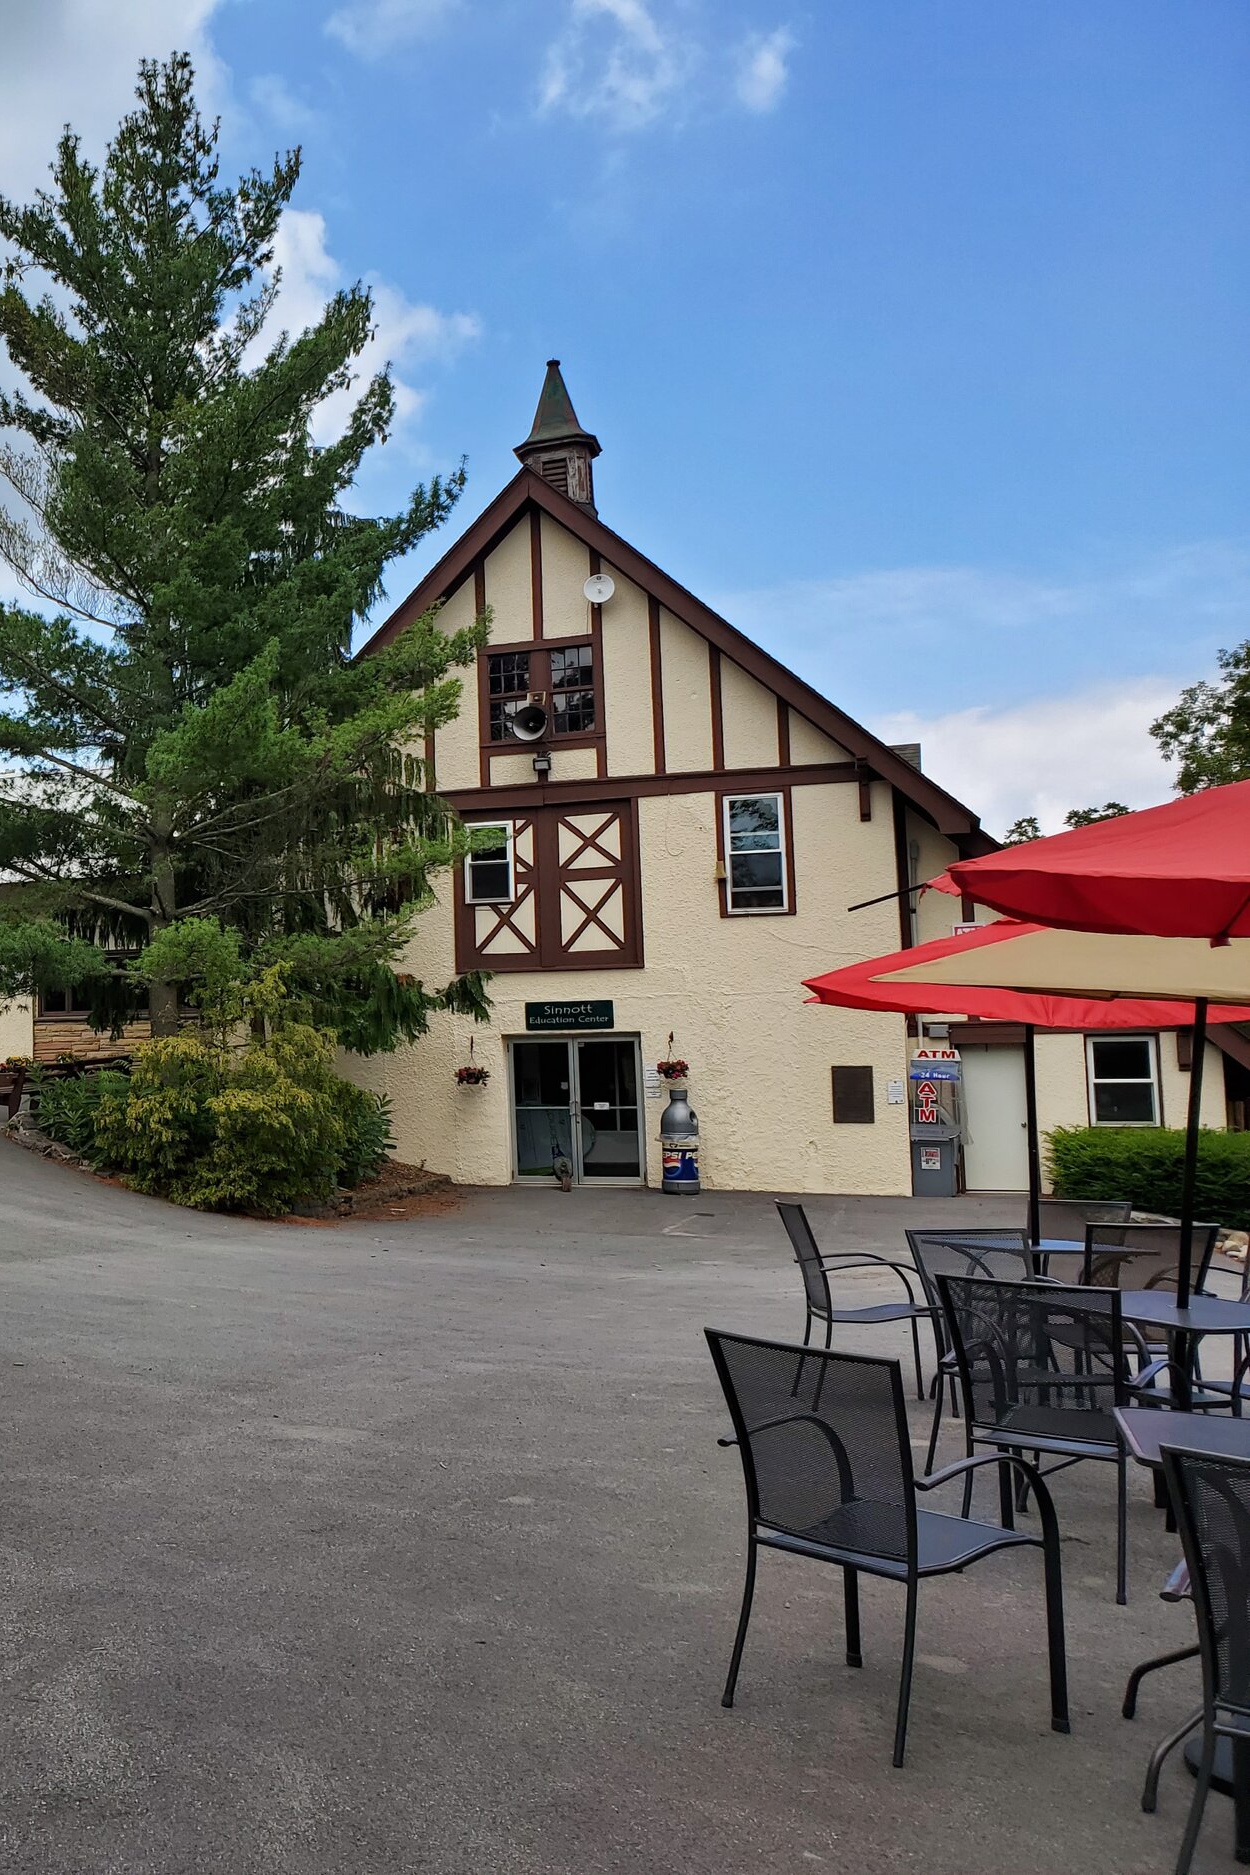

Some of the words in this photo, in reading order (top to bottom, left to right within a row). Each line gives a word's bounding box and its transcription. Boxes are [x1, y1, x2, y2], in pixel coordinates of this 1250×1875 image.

[544, 1004, 593, 1015] Sinnott
[529, 1016, 575, 1024] Education
[578, 1015, 609, 1023] Center
[917, 1050, 956, 1059] ATM
[918, 1082, 937, 1122] ATM
